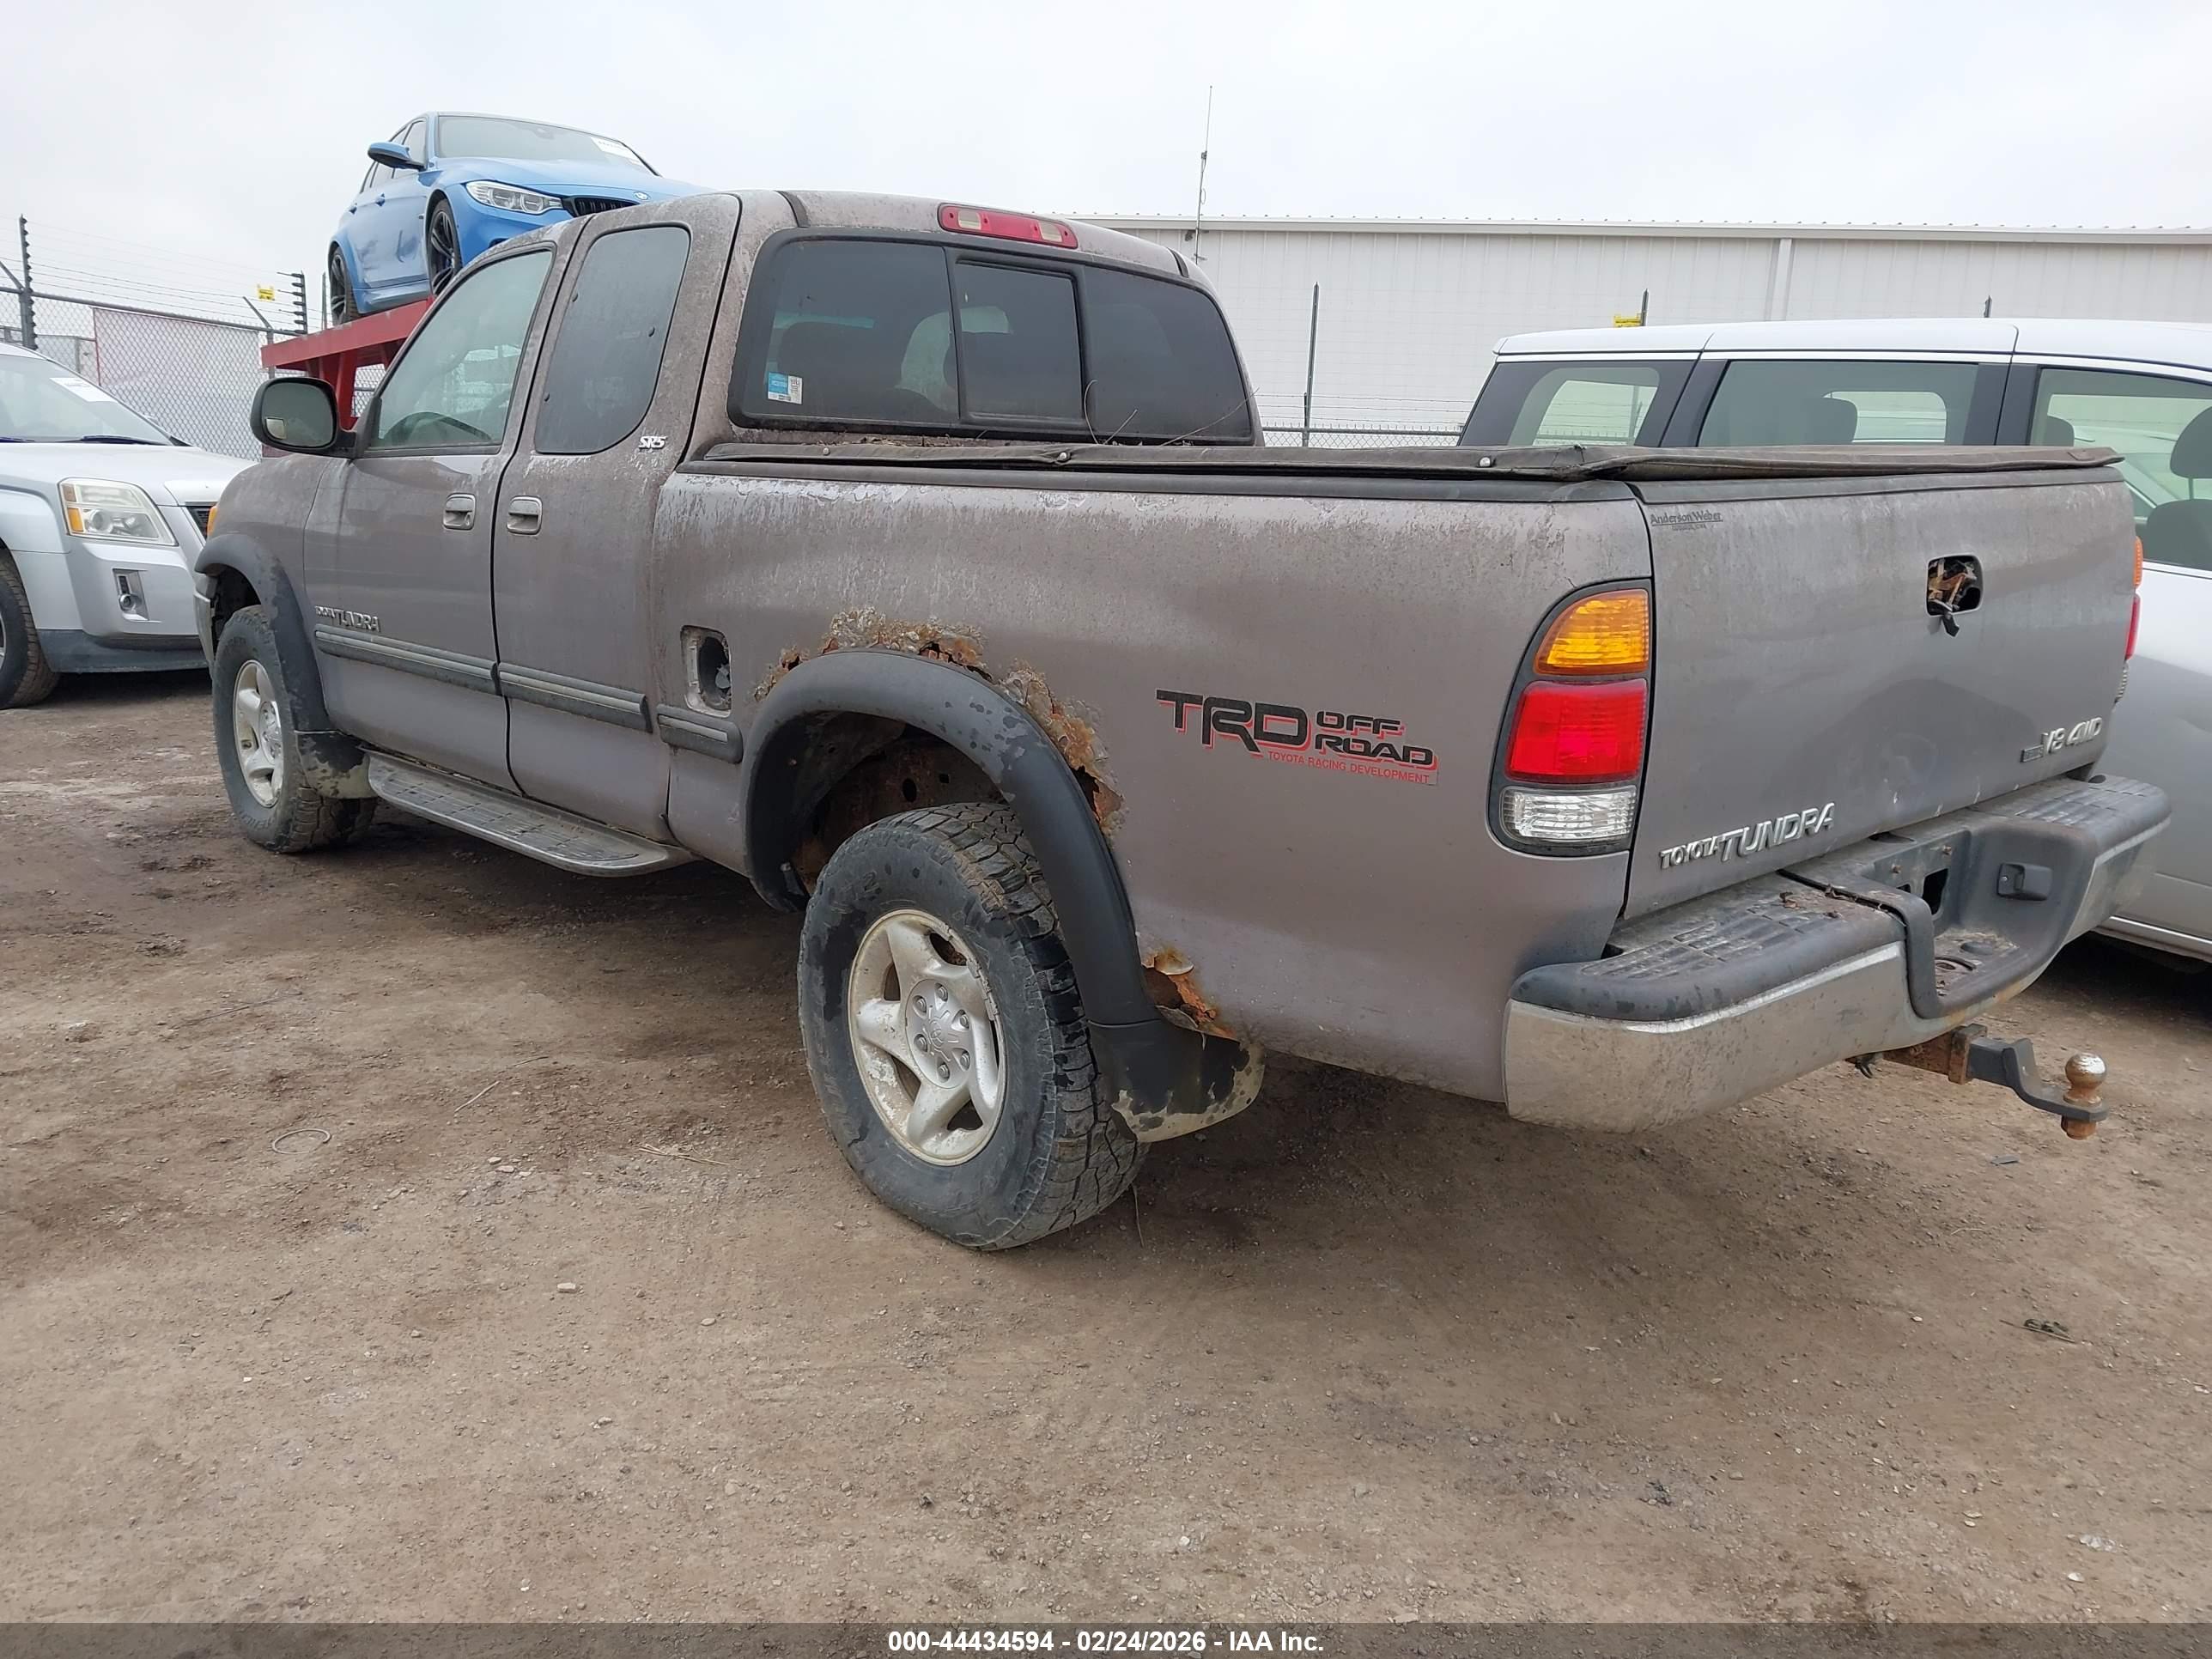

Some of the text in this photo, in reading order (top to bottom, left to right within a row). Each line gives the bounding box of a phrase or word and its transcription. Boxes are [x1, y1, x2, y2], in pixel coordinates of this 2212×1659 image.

[638, 435, 667, 449] SR5
[1650, 509, 1722, 525] Anderson Weber
[1156, 688, 1311, 757] TRD
[1315, 710, 1406, 738] OFF
[1314, 732, 1437, 770] ROAD
[2042, 727, 2065, 754] V8
[1267, 750, 1430, 784] TOYOTA RACING DEVELOPMENT
[1660, 801, 1835, 869] TOYOTA TUNDRA
